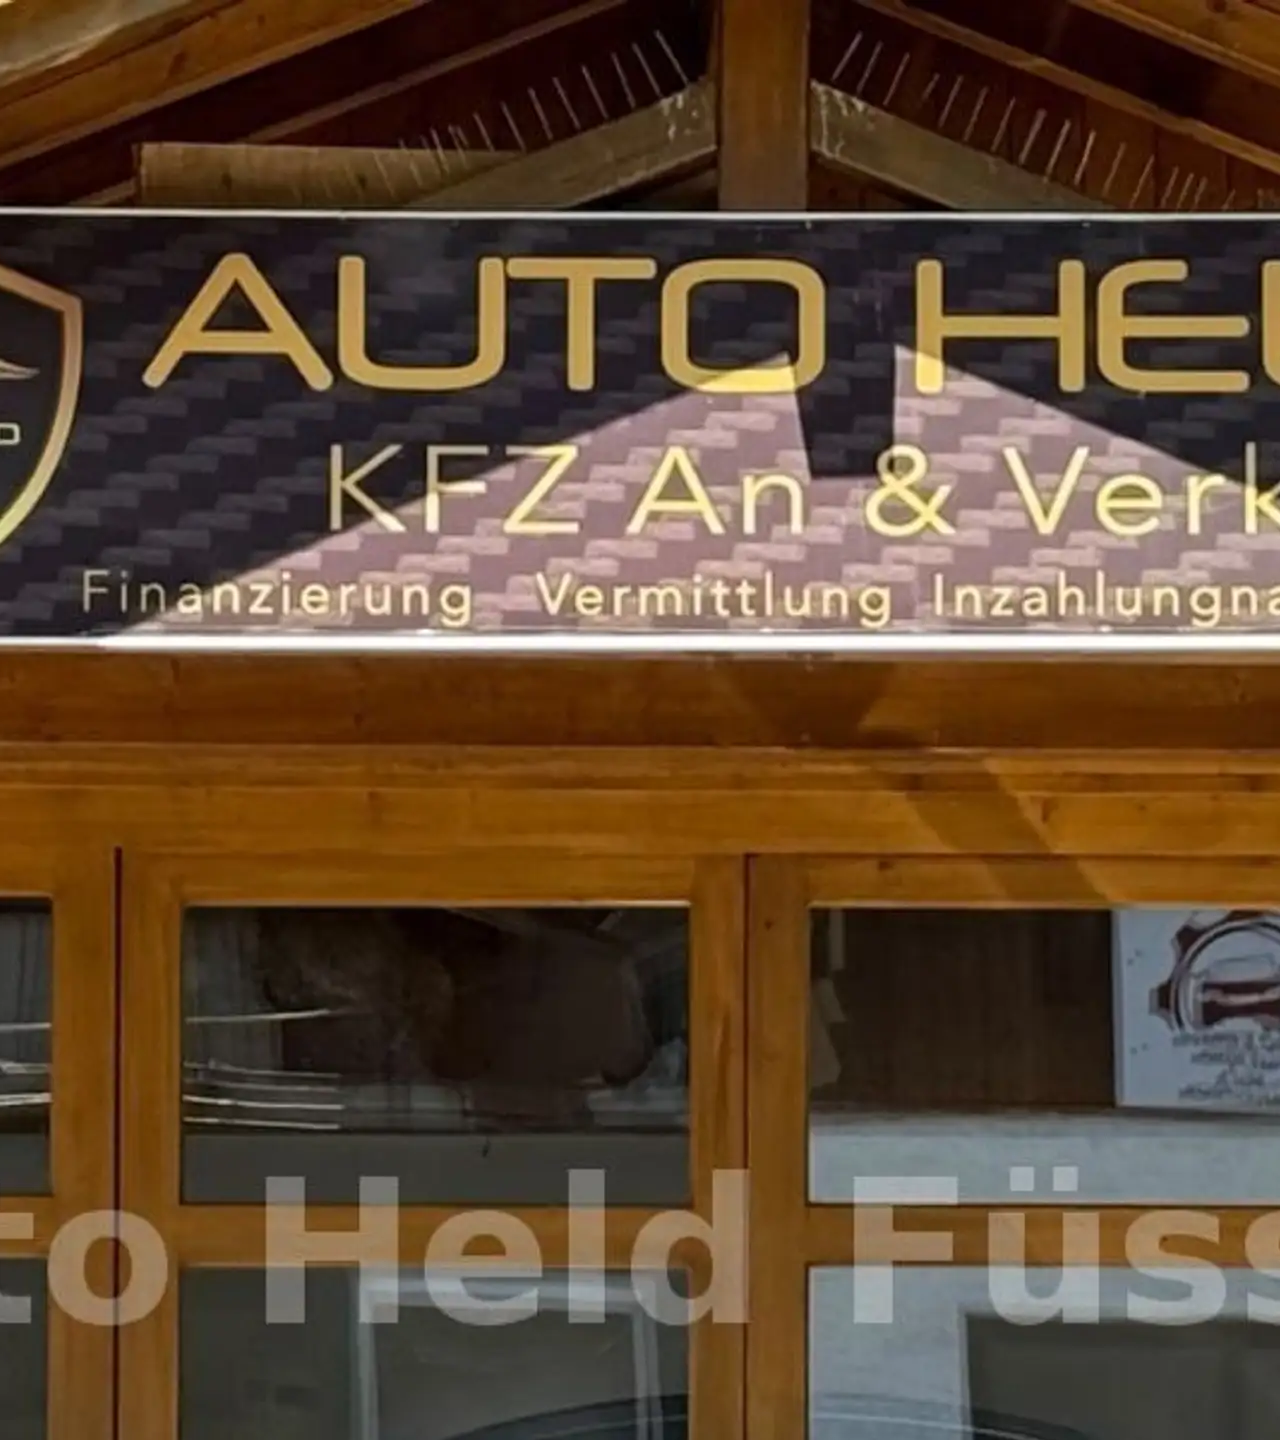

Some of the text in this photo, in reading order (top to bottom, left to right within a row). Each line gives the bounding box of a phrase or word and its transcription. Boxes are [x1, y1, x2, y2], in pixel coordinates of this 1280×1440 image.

[142, 252, 825, 394] AUTO
[329, 443, 581, 536] KFZ
[627, 444, 805, 536] An
[864, 443, 956, 537] &
[82, 568, 472, 625] Finanzierung
[536, 570, 892, 626] Vermittlung
